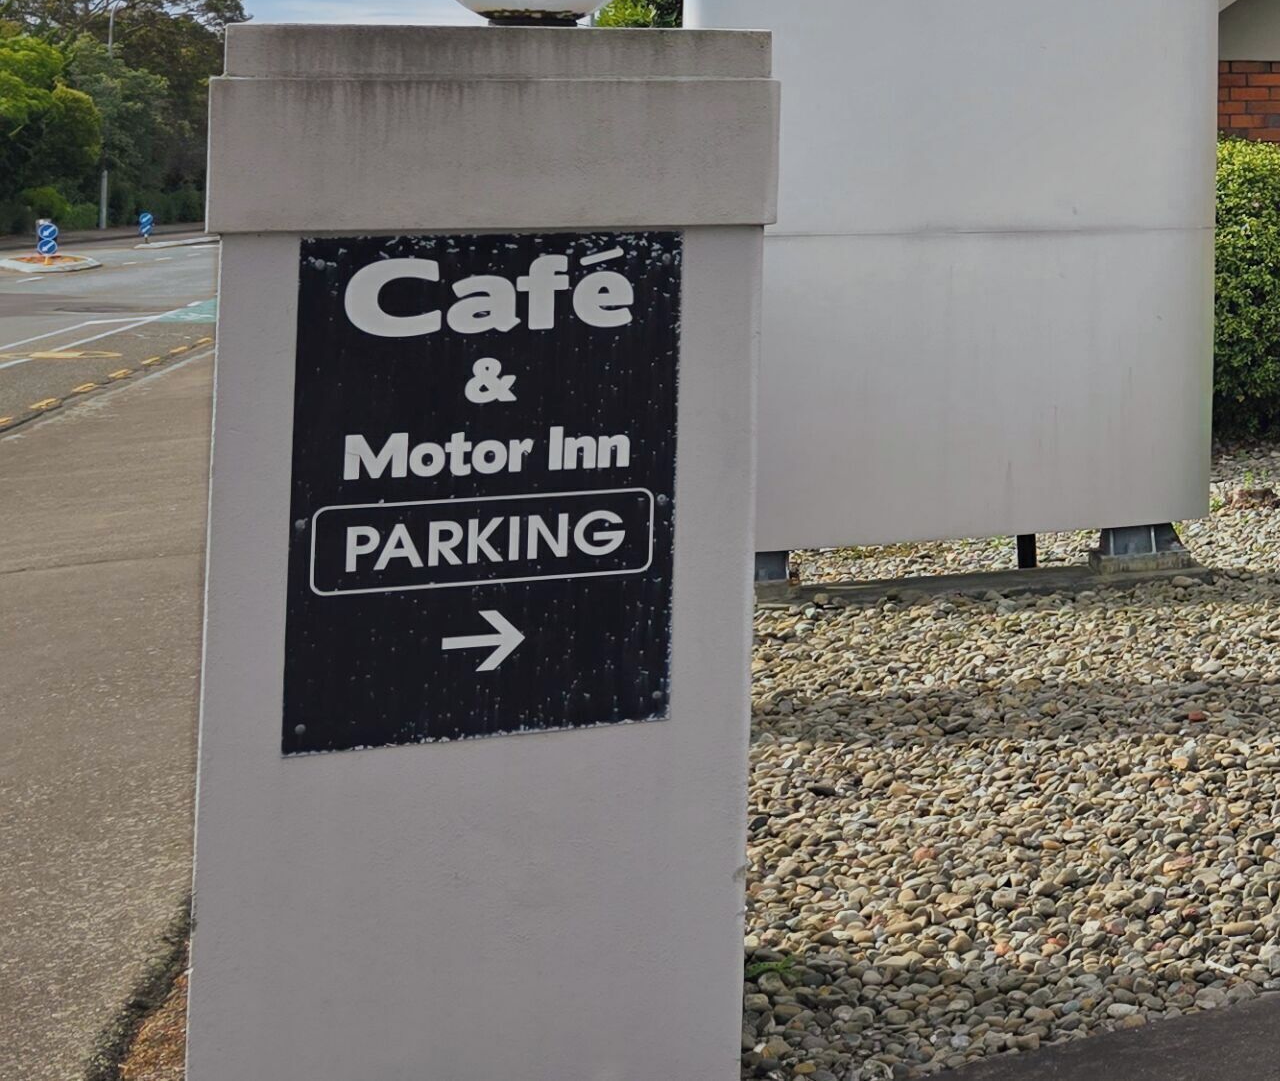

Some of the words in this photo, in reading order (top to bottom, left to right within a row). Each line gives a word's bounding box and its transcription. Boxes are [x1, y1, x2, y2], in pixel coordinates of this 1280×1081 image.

[344, 246, 634, 337] Café
[464, 357, 517, 404] &
[343, 431, 534, 481] Motor
[548, 426, 631, 471] Inn
[345, 509, 626, 572] PARKING
